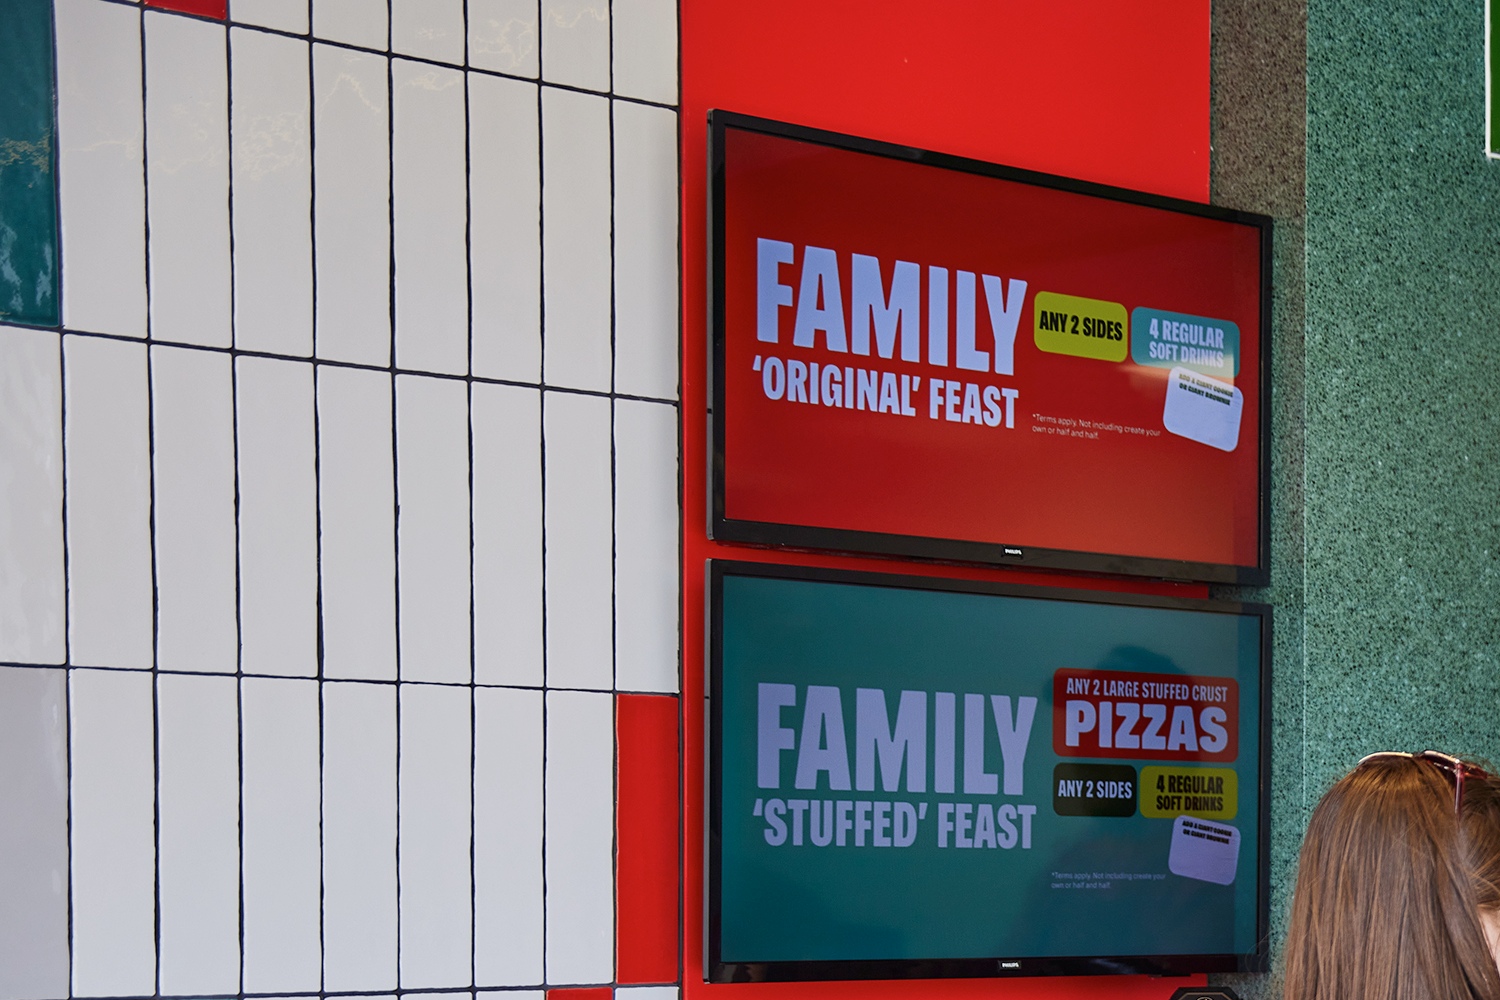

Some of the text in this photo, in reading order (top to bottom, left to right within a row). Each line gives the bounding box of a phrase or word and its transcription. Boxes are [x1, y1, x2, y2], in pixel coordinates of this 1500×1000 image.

[757, 237, 1027, 376] FAMILY
[1040, 311, 1123, 342] ANY 2 SIDES
[1150, 318, 1224, 349] 4 REGULAR
[1149, 342, 1224, 368] SOFT DRINKS
[930, 378, 1020, 430] FEAST
[1066, 678, 1228, 702] ANY 2 LARGE STUFFED CRUST
[757, 682, 1038, 796] FAMILY
[1066, 700, 1228, 753] PIZZAS
[1058, 780, 1132, 799] ANY 2 SIDES
[1157, 775, 1224, 795] 4 REGULAR
[1156, 796, 1223, 812] SOFT DRINKS
[938, 802, 1037, 849] FEAST
